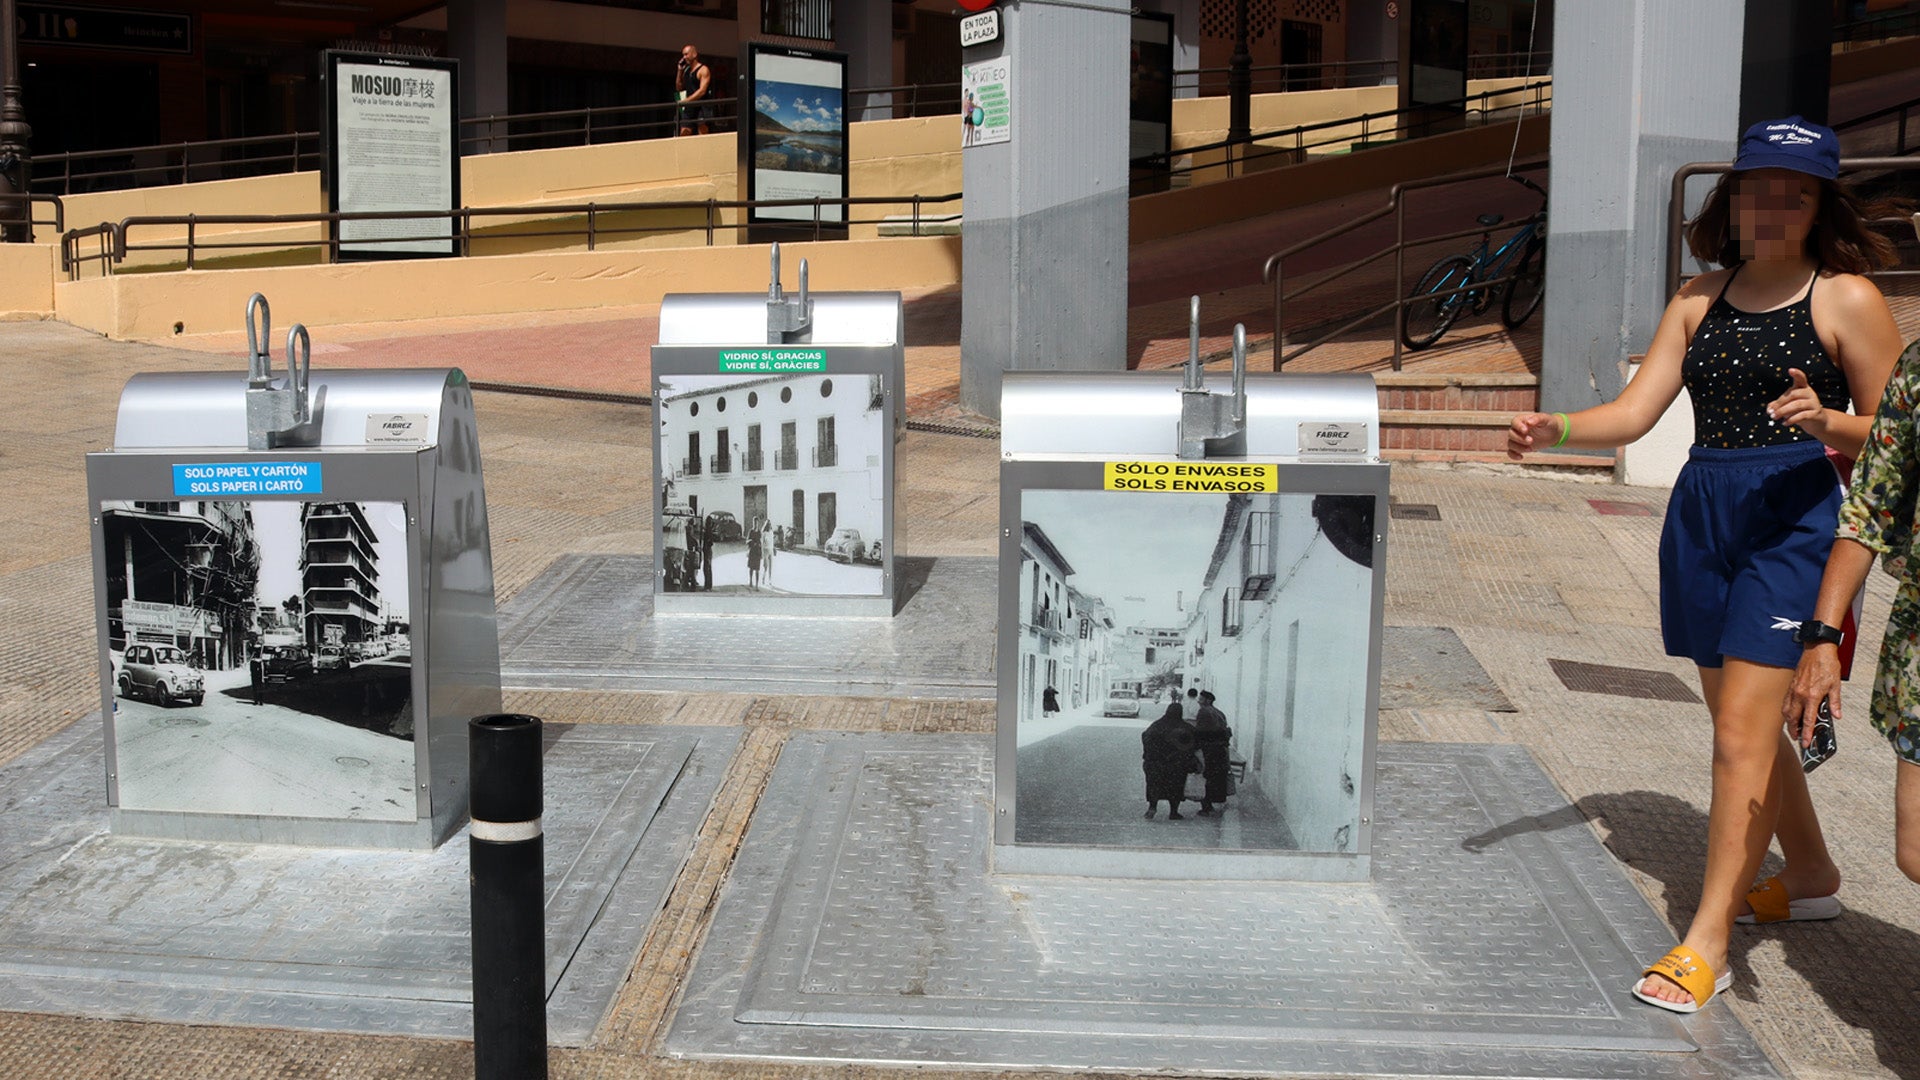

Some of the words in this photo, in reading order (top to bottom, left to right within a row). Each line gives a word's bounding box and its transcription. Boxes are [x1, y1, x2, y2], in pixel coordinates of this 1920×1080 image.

[964, 21, 974, 30] EN
[975, 16, 993, 27] TODA
[964, 32, 972, 42] LA
[974, 27, 995, 39] PLAZA
[352, 74, 401, 96] MOSUO
[402, 78, 435, 99] 摩梭
[352, 97, 366, 106] Viaje
[412, 101, 435, 109] mujeres
[761, 351, 774, 361] SÍ,
[759, 361, 772, 370] SÍ,
[774, 360, 819, 369] GRÀCIES
[185, 467, 214, 478] SOLO
[217, 466, 250, 477] PAPEL
[252, 466, 259, 476] Y
[261, 464, 307, 476] CARTÓN
[1115, 462, 1169, 475] SÓLO
[1175, 466, 1265, 476] ENVASES
[191, 482, 220, 493] SOLS
[222, 481, 257, 492] PAPER
[259, 481, 262, 491] I
[265, 478, 303, 491] CARTÓ
[1114, 478, 1166, 490] SOLS
[1172, 480, 1265, 492] ENVASOS
